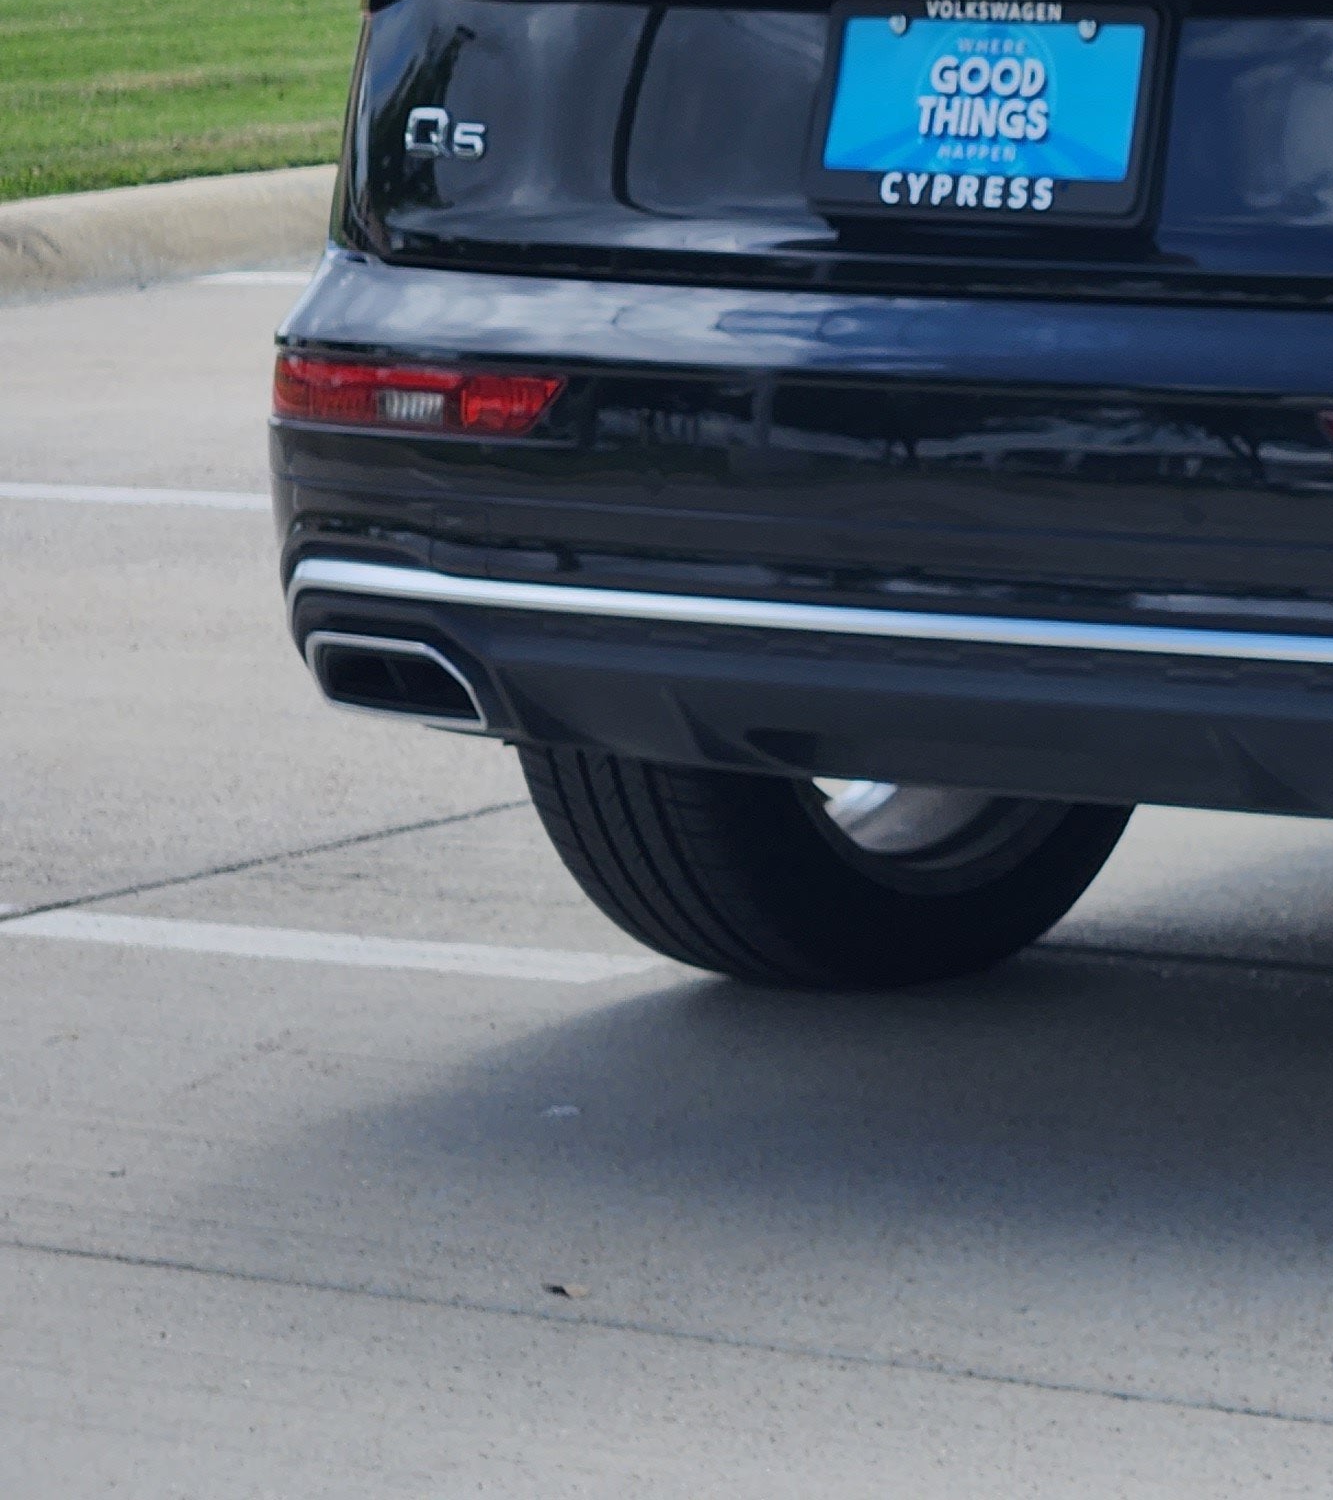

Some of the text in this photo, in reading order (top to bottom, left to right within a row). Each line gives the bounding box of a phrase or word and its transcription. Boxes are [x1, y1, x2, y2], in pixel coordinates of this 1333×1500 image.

[926, 0, 1062, 21] VOLKSWAGEN
[930, 55, 1046, 97] GOOD
[404, 106, 485, 159] Q5
[917, 97, 1048, 140] THINGS
[880, 172, 1053, 211] CYPRESS
